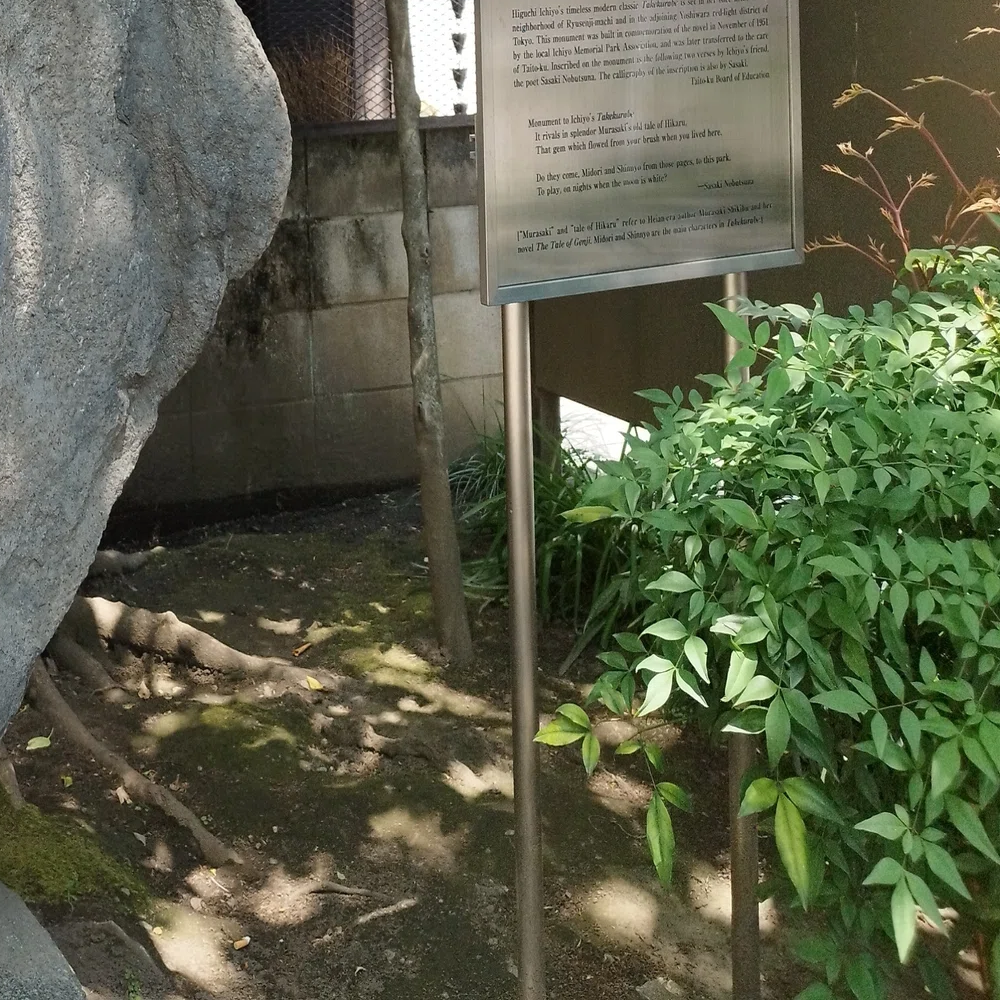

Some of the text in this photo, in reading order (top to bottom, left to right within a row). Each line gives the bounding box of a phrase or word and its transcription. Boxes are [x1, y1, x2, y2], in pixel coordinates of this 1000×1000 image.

[511, 7, 538, 21] Higuchi
[539, 5, 563, 18] Ichiyo's
[565, 4, 591, 14] timeless
[593, 2, 616, 12] modern
[512, 19, 554, 34] neighborhood
[556, 19, 563, 28] of
[615, 14, 626, 24] and
[536, 34, 550, 44] This
[552, 33, 584, 43] monument
[600, 29, 614, 39] built
[616, 29, 623, 38] in
[673, 24, 679, 33] of
[681, 23, 691, 33] the
[692, 21, 708, 32] novel
[748, 18, 754, 28] of
[512, 49, 522, 61] by
[523, 48, 533, 57] the
[535, 46, 550, 57] local
[550, 45, 572, 58] Ichiyo
[573, 42, 603, 54] Memorial
[605, 41, 620, 51] Park
[659, 37, 671, 47] and
[745, 31, 754, 41] the
[512, 63, 519, 73] of
[550, 58, 580, 70] Inscribed
[591, 57, 601, 67] the
[602, 55, 634, 65] monument
[683, 51, 695, 59] two
[716, 47, 723, 59] by
[726, 45, 748, 58] Ichiyo's
[513, 77, 524, 87] the
[525, 77, 538, 89] poet
[540, 74, 560, 85] Sasaki
[599, 70, 610, 80] The
[719, 60, 726, 72] by
[741, 70, 769, 80] Education
[528, 112, 594, 127] Monument to Ichiyo's
[535, 132, 540, 140] It
[542, 129, 560, 140] rivals
[561, 129, 568, 138] in
[570, 126, 596, 140] splendor
[598, 122, 631, 134] Murasaki's
[644, 120, 655, 130] tale
[656, 119, 662, 129] of
[536, 144, 550, 154] That
[552, 145, 565, 156] gem
[568, 140, 586, 151] which
[588, 138, 608, 149] flowed
[610, 137, 624, 147] from
[642, 133, 659, 144] brush
[661, 132, 677, 142] when
[678, 133, 689, 143] you
[691, 128, 705, 139] lived
[536, 173, 545, 182] Do
[546, 171, 560, 183] they
[581, 166, 602, 177] Midori
[603, 164, 615, 175] and
[642, 161, 657, 171] from
[658, 159, 673, 169] those
[703, 154, 714, 164] this
[537, 187, 545, 195] To
[572, 181, 591, 194] nights
[593, 179, 609, 189] when
[611, 178, 620, 188] the
[647, 173, 668, 184] white?
